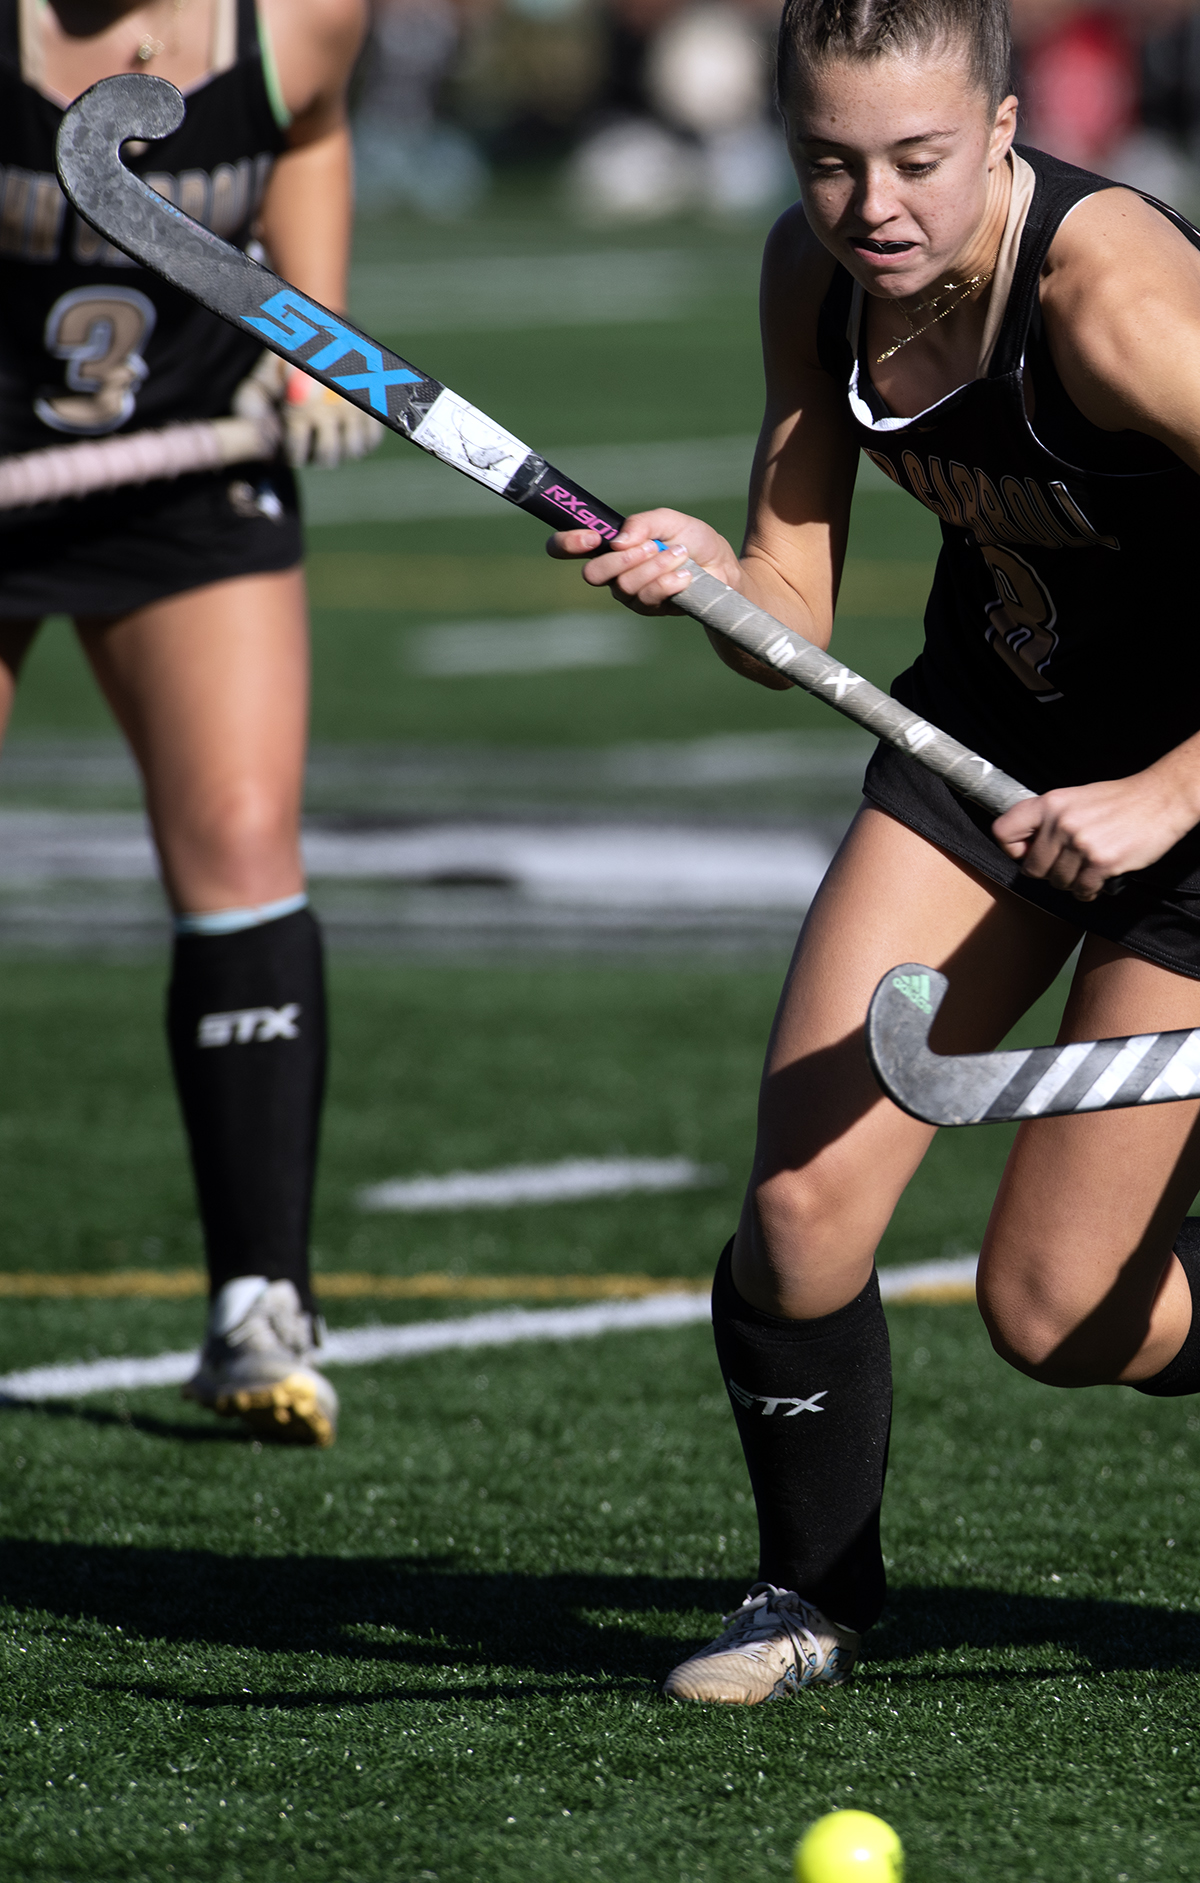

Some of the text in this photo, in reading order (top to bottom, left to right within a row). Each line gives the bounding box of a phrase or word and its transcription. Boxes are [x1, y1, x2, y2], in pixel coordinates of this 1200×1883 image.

[33, 284, 157, 435] 3
[239, 289, 424, 417] STX
[901, 449, 1120, 550] CARROLL
[196, 1002, 302, 1049] STX
[729, 1378, 830, 1417] STX
